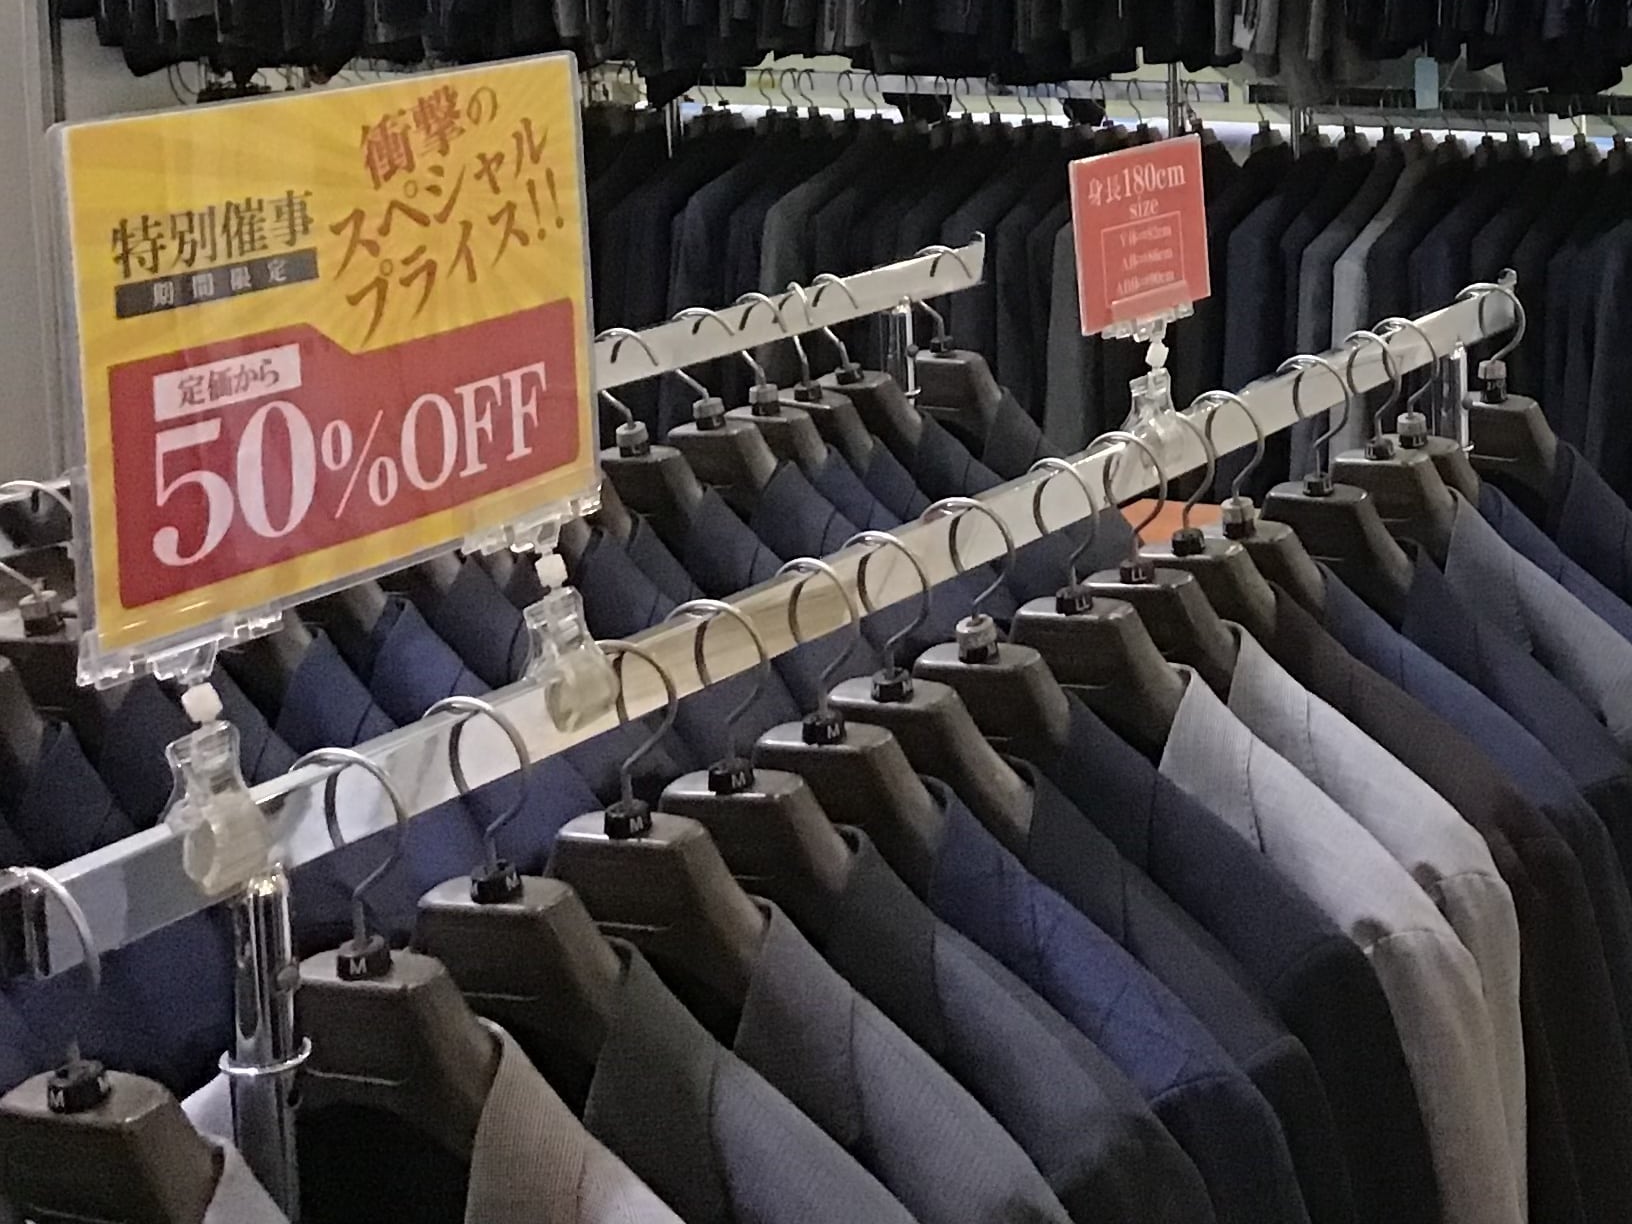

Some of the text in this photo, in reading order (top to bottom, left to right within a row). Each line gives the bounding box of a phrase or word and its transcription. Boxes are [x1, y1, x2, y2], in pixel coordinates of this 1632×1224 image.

[361, 84, 499, 191] 衝撃の
[330, 117, 550, 279] スペシャル
[1088, 161, 1186, 207] 身長180cm
[1129, 196, 1160, 218] size
[111, 190, 314, 278] 特別催事
[153, 262, 288, 307] 期間限定
[178, 363, 281, 408] 定価から
[152, 361, 549, 567] 50%OFF
[731, 771, 746, 788] M
[629, 816, 644, 833] M
[350, 957, 367, 974] M
[50, 1088, 65, 1108] M
